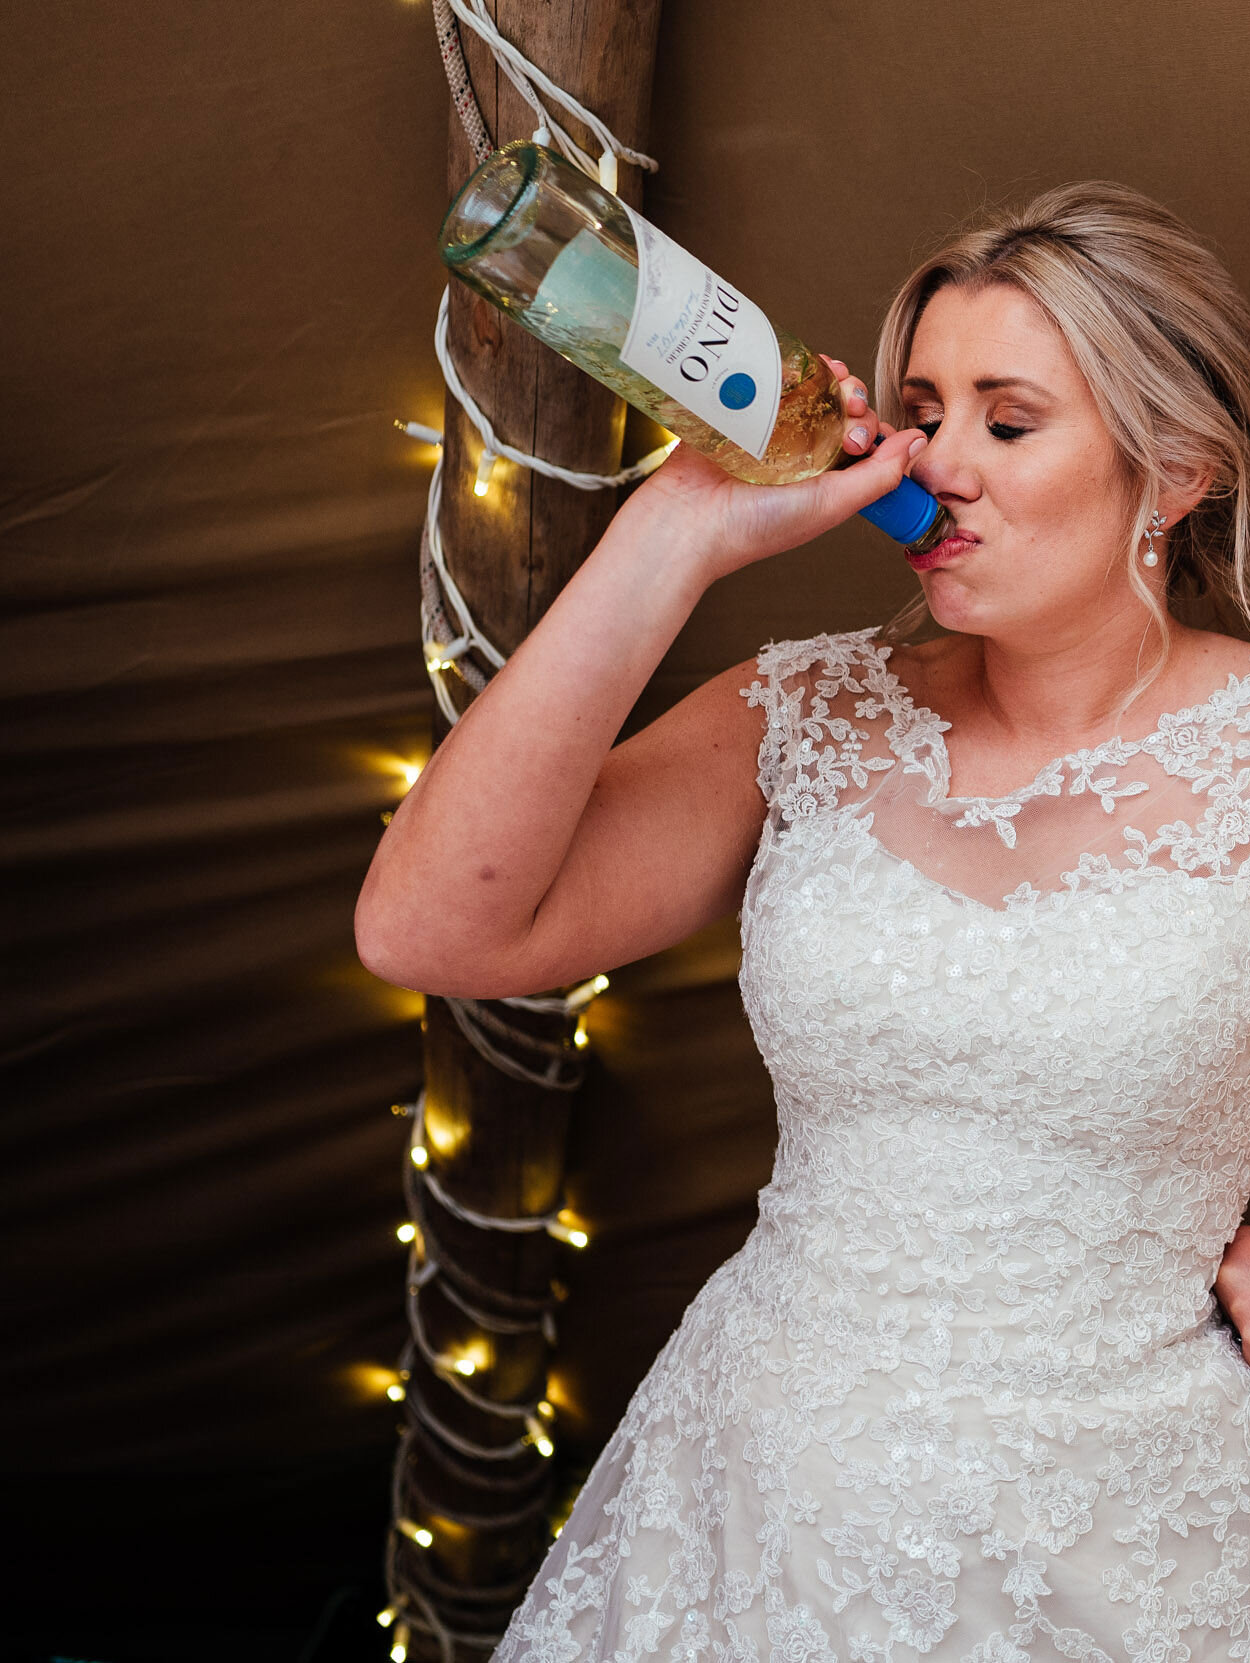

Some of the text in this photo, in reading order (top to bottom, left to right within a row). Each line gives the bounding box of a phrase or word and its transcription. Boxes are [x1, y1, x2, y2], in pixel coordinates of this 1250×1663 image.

[680, 283, 739, 382] DINO
[688, 307, 706, 336] PINOT
[665, 335, 691, 364] GRIGIO
